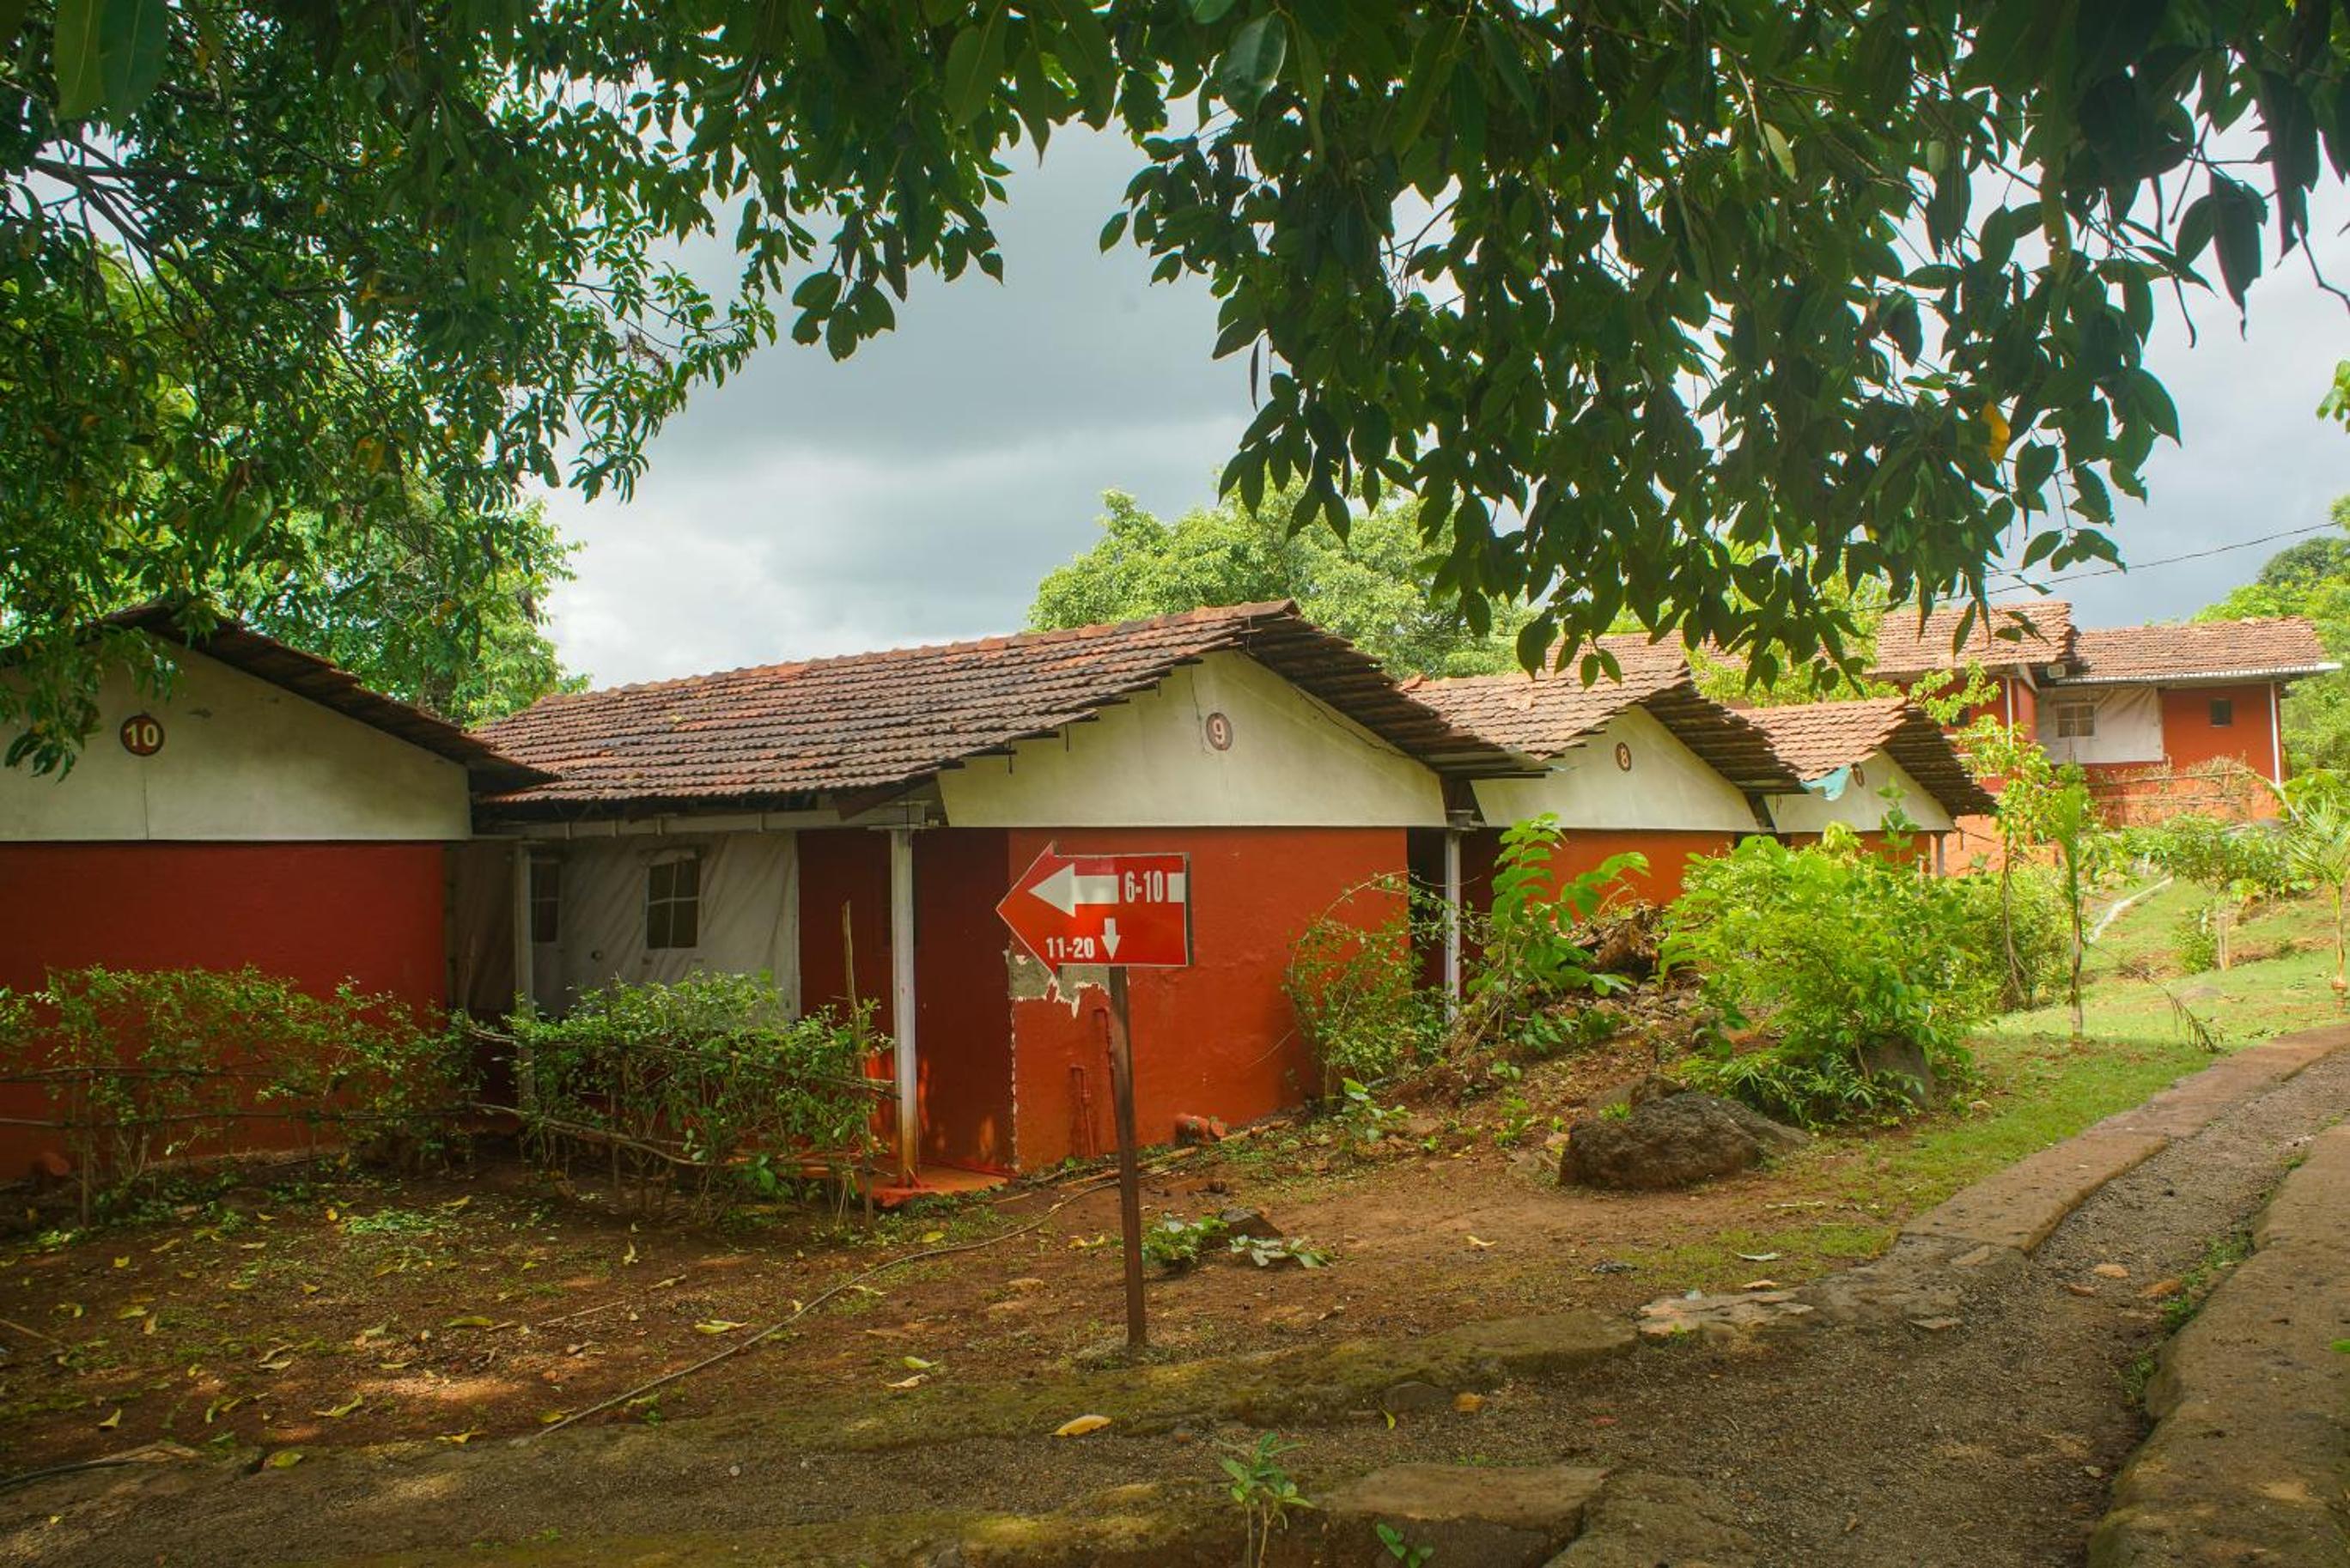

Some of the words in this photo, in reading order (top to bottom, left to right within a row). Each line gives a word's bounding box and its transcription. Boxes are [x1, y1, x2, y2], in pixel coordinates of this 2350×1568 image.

[125, 724, 159, 746] 10
[1213, 719, 1226, 744] 9
[1621, 748, 1629, 769] 8
[1124, 870, 1164, 903] 6-10
[1045, 937, 1095, 959] 11-20
